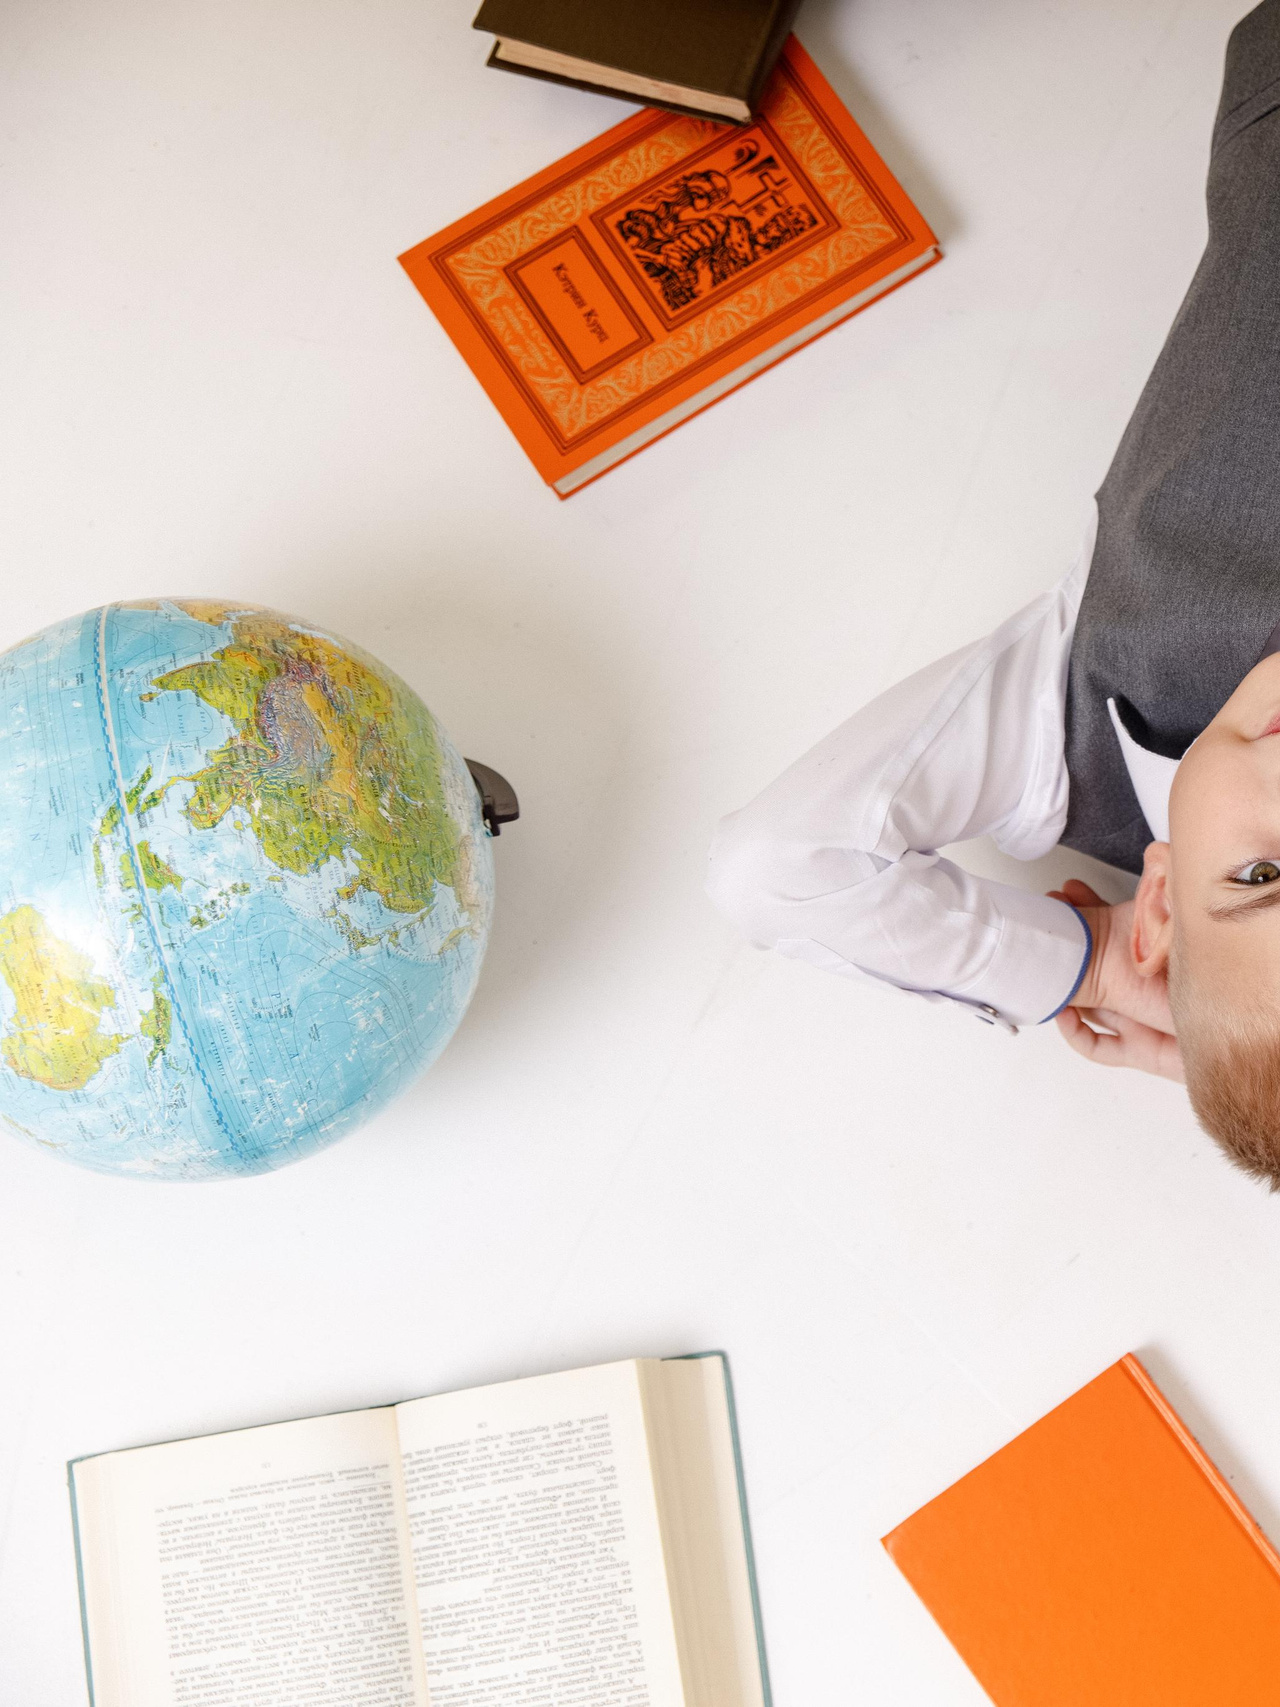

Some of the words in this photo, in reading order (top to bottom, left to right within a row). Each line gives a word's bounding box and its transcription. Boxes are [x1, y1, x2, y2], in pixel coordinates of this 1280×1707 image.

[552, 262, 586, 308] Кэтрин
[582, 308, 608, 342] Курц
[333, 862, 341, 884] YELLOW
